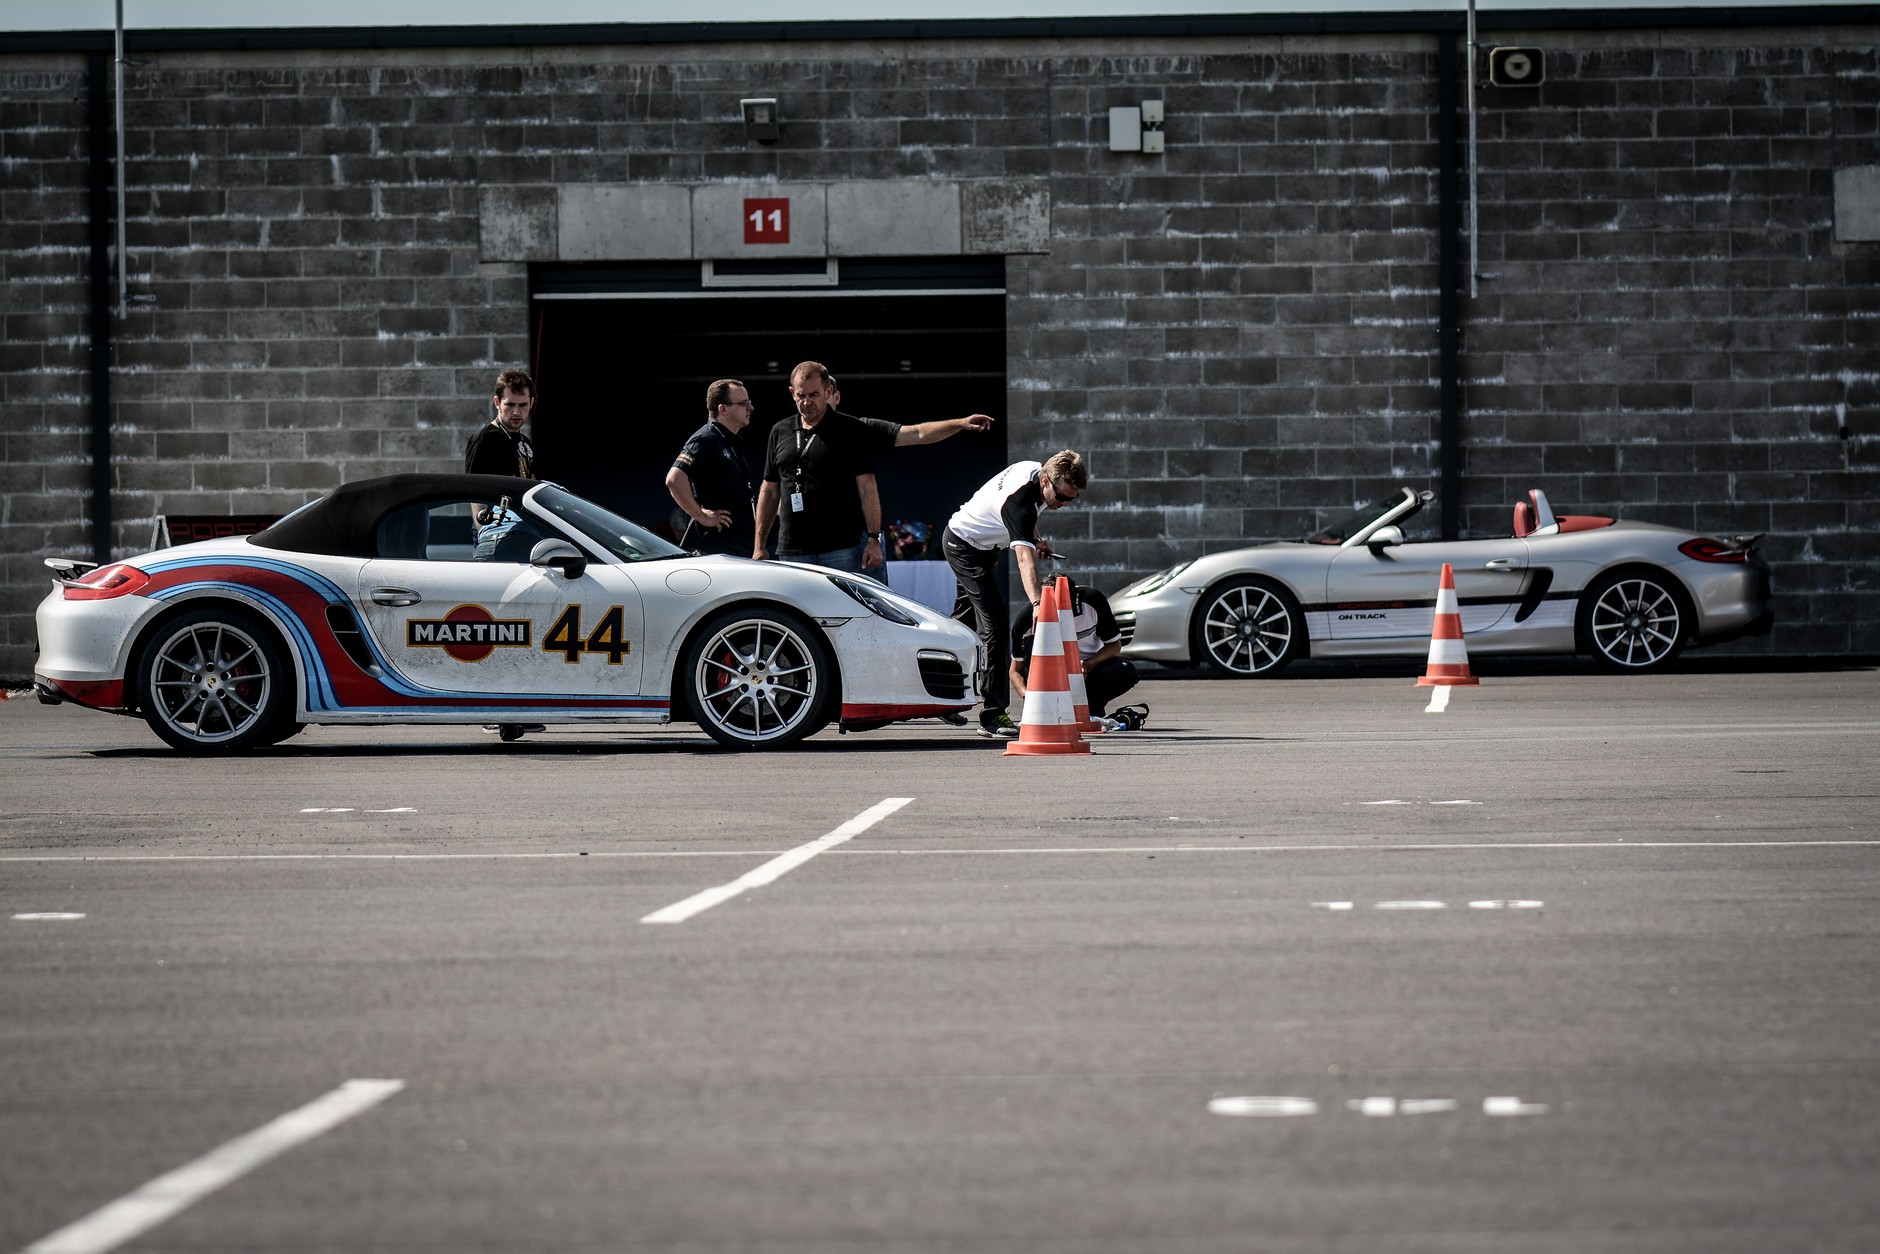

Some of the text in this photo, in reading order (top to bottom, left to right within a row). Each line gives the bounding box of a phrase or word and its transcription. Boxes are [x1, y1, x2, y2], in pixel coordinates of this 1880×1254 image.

[749, 209, 782, 232] 11
[1338, 612, 1386, 621] ON TRACK
[415, 624, 524, 642] MARTINI
[542, 603, 630, 665] 44
